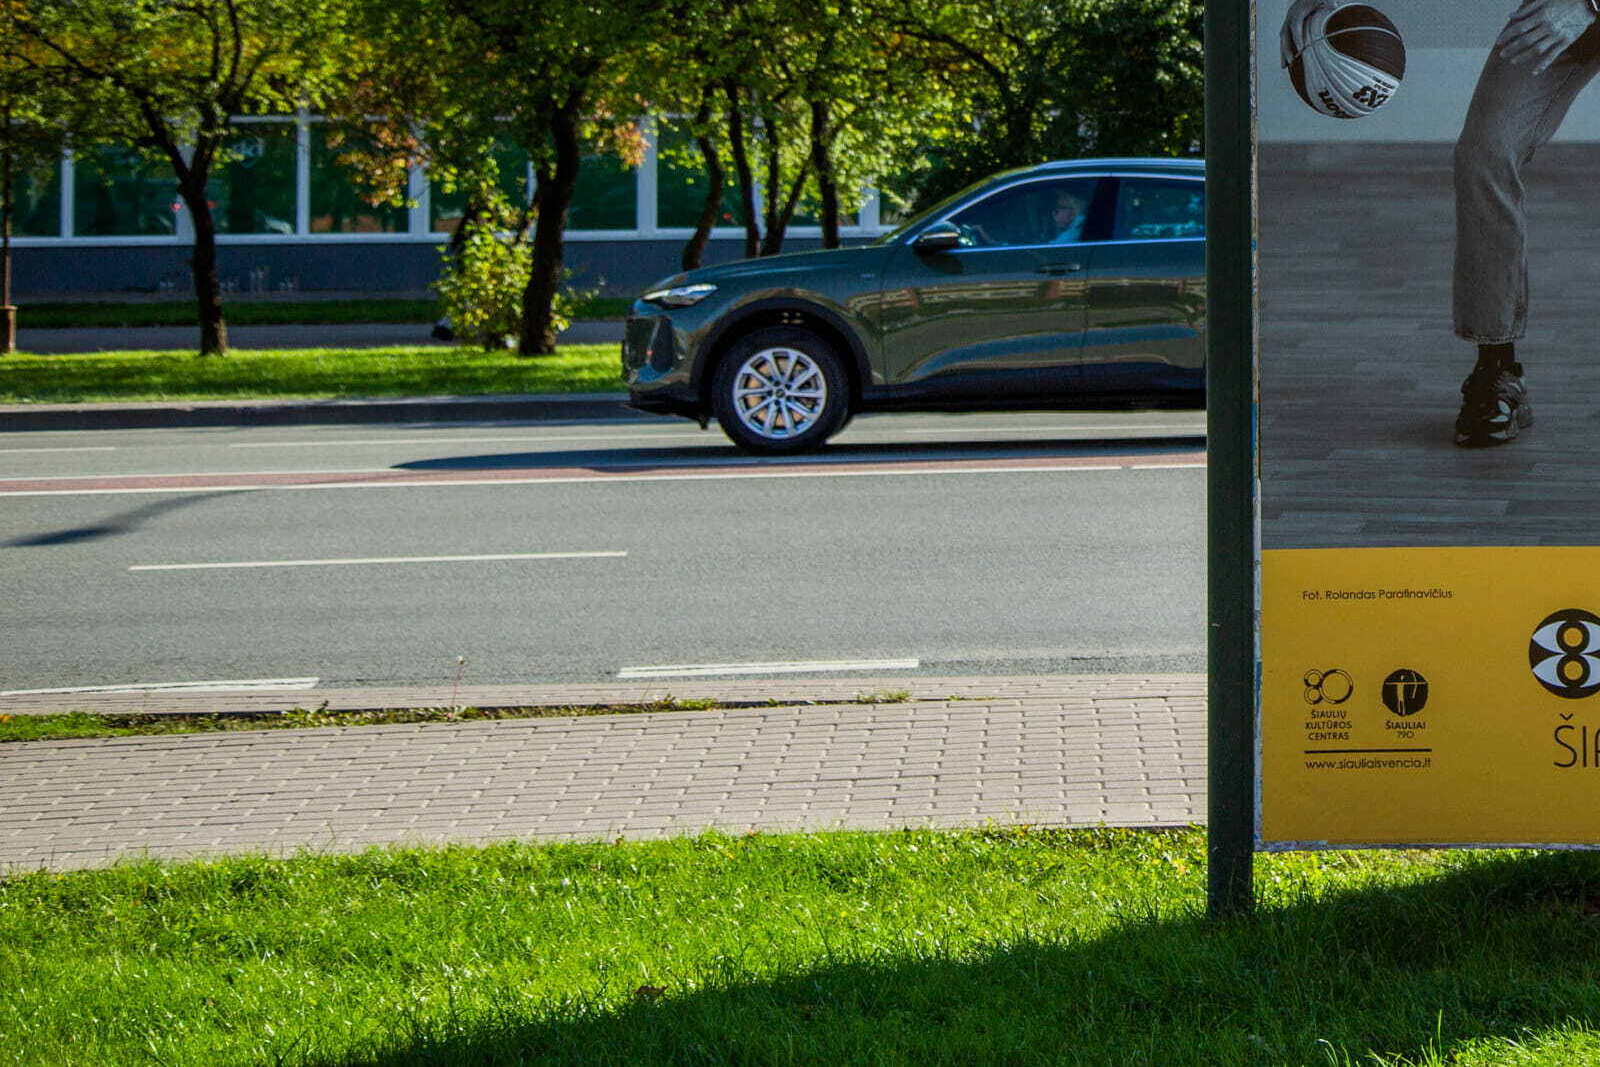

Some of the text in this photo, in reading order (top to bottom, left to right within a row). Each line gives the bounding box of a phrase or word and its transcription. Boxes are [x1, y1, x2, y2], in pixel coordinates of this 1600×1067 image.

[1303, 590, 1322, 600] Fot.
[1326, 590, 1376, 600] Rolandas
[1305, 719, 1353, 730] KULTŪROS
[1385, 719, 1426, 730] ŠIAULIAI
[1308, 731, 1350, 741] CENTRAS
[1305, 757, 1431, 770] www.siauliaisvencia.lt
